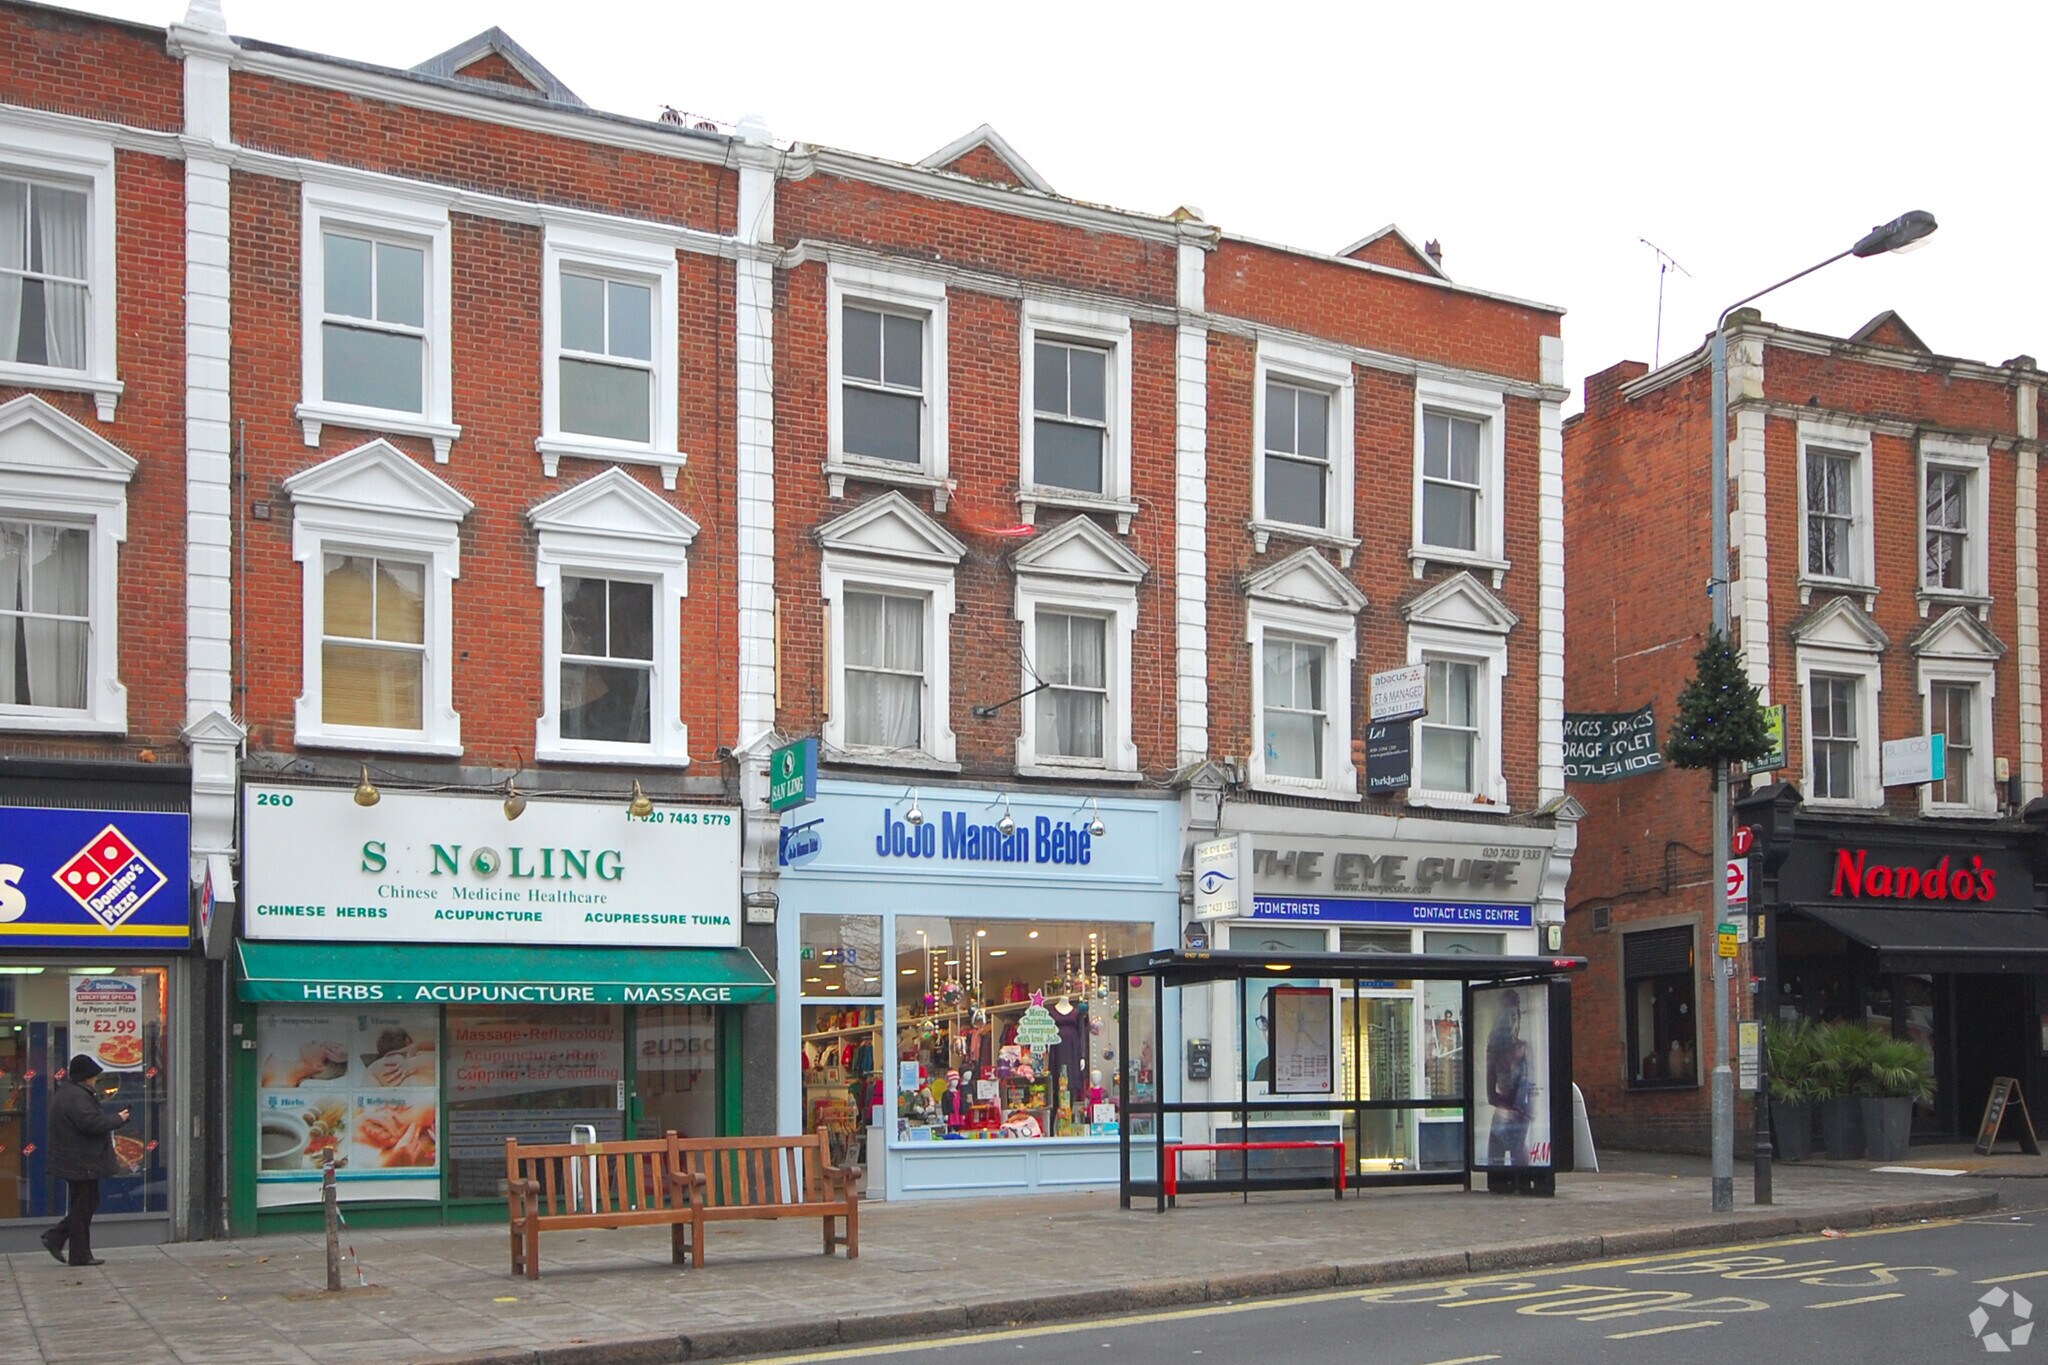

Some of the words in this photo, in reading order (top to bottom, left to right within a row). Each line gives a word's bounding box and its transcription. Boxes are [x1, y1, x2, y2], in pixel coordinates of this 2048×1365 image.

[1375, 672, 1407, 685] abacus
[1389, 685, 1423, 700] MANAGED
[772, 782, 786, 801] SAN
[787, 776, 803, 797] LING
[257, 793, 294, 807] 260
[668, 812, 698, 824] 7443
[703, 814, 731, 826] 5779
[876, 808, 936, 859] JoJo
[942, 811, 1029, 863] Maman
[1035, 815, 1092, 866] Bébé
[1737, 831, 1747, 850] T
[1483, 848, 1499, 858] 020
[1500, 849, 1520, 859] 7433
[1523, 850, 1542, 860] 1333
[1253, 849, 1324, 878] THE
[1333, 852, 1409, 882] EYE
[1416, 856, 1521, 888] CUBE
[1832, 848, 1997, 902] Nando's
[90, 863, 145, 912] Domino's
[378, 884, 439, 899] Chinese
[452, 886, 521, 901] Medicine
[528, 889, 608, 904] Healthcare
[1334, 881, 1432, 896] www.theeyecube.com
[101, 891, 139, 924] Pizza
[257, 905, 326, 917] CHINESE
[336, 907, 388, 918] HERBS
[434, 909, 543, 922] ACUPUNCTURE
[585, 913, 687, 925] ACUPRESSURE
[691, 915, 731, 926] TUINA
[1413, 907, 1456, 919] CONTACT
[1458, 909, 1482, 920] LENS
[1485, 910, 1520, 921] CENTRE
[824, 948, 856, 964] 258
[303, 984, 384, 1000] HERBS
[415, 986, 595, 1001] ACUPUNCTURE
[624, 987, 731, 1002] MASSAGE
[75, 1006, 88, 1014] Any
[89, 1005, 117, 1013] Personal
[75, 1018, 90, 1026] only
[94, 1019, 136, 1034] £2.99
[1022, 1017, 1053, 1026] Christmas
[456, 1028, 521, 1043] Massage
[530, 1027, 615, 1042] Reflexology
[464, 1050, 558, 1065] Acupuncture
[457, 1067, 519, 1083] Cupping
[528, 1068, 551, 1080] Ear
[556, 1067, 619, 1081] Candling
[281, 1098, 305, 1107] Herbs
[1626, 1256, 1958, 1288] BUS
[1360, 1281, 1770, 1322] STOP
